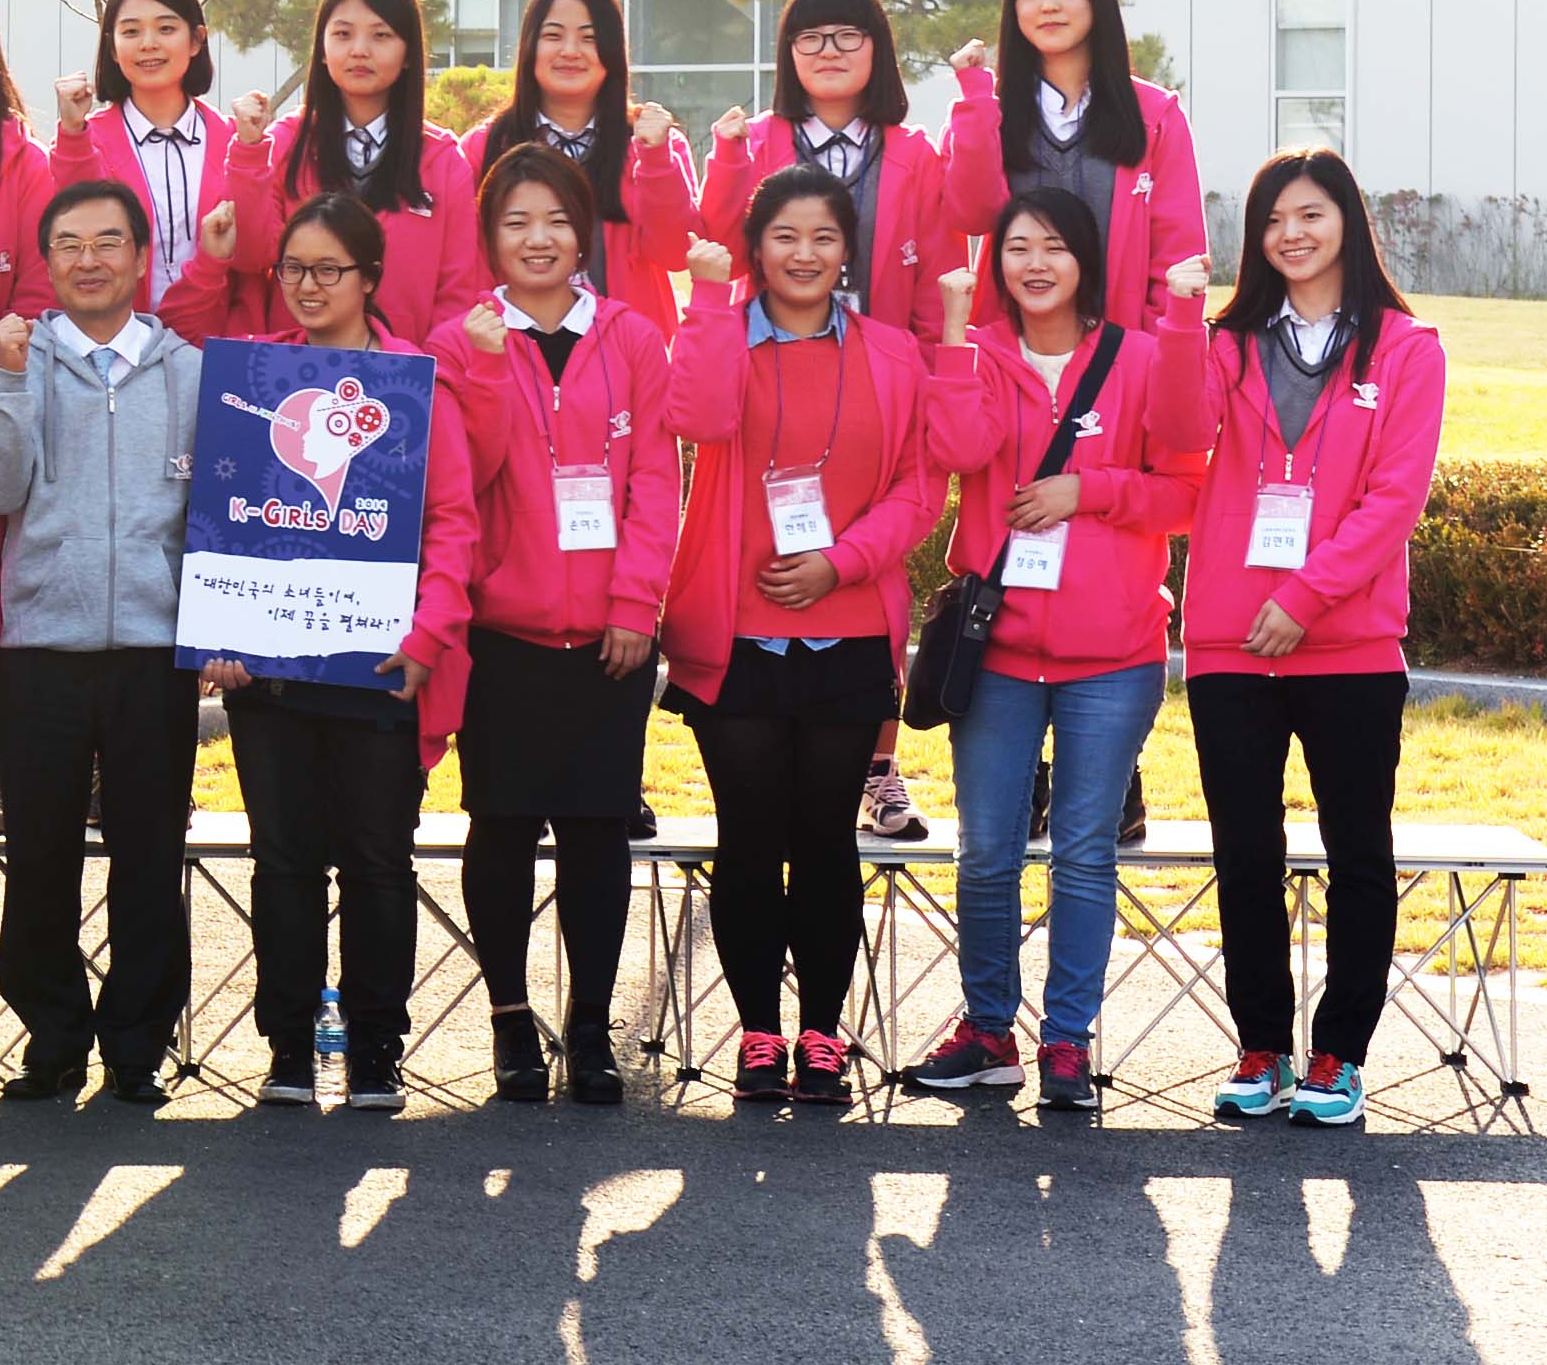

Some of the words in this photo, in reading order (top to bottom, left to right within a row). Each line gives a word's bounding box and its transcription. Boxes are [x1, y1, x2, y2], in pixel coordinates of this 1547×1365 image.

[339, 509, 388, 541] DAY
[267, 607, 294, 621] 이제
[304, 611, 330, 630] 꿈을
